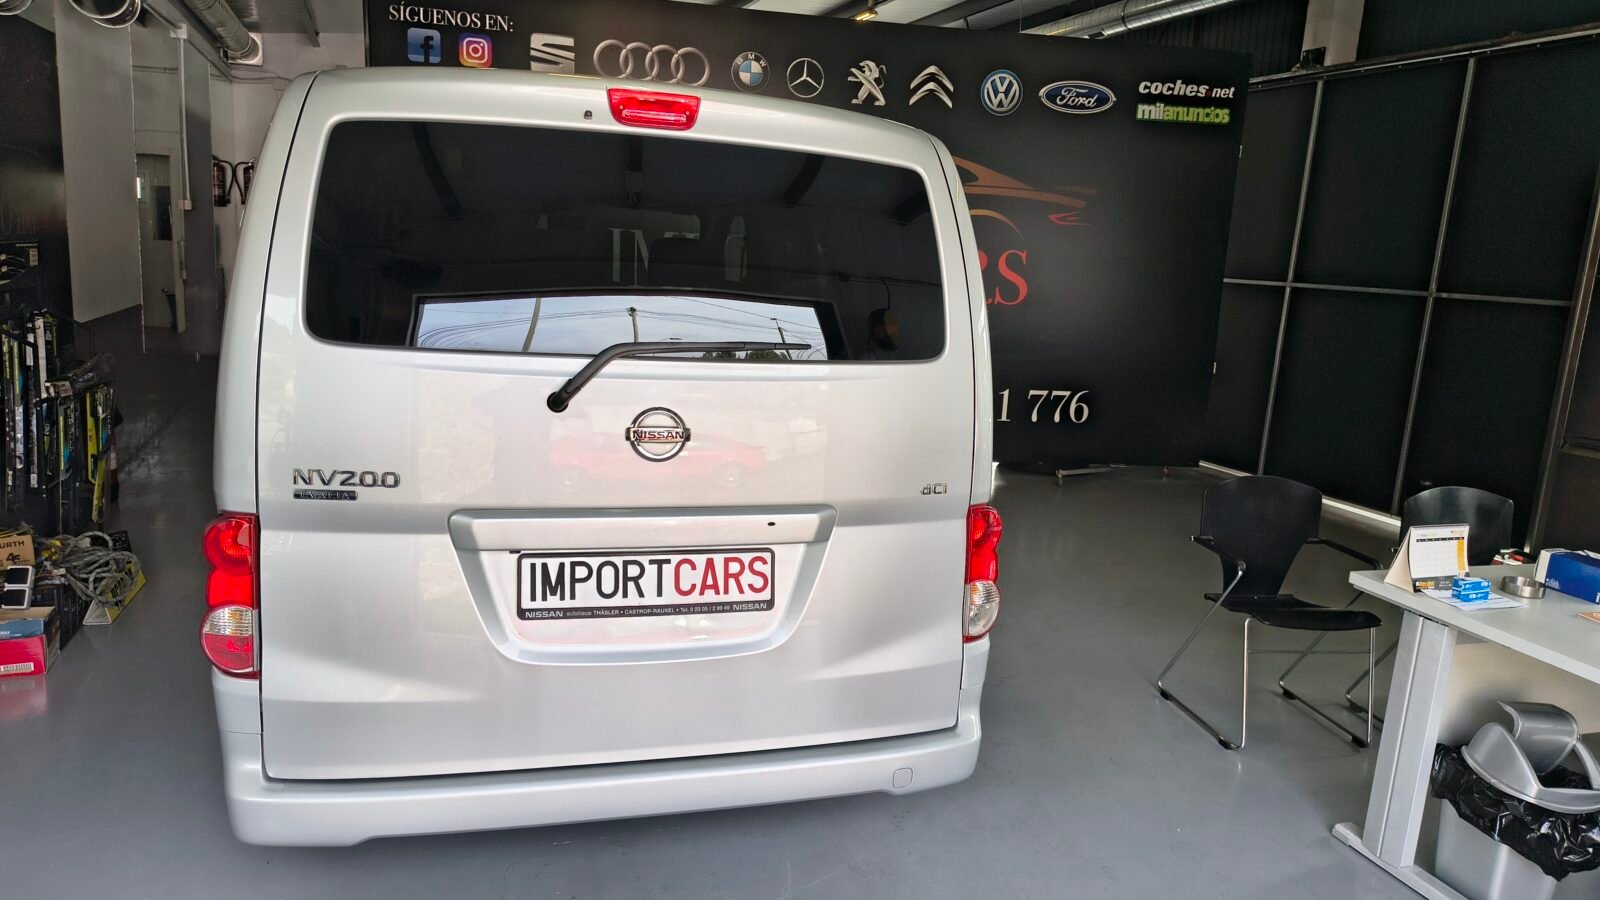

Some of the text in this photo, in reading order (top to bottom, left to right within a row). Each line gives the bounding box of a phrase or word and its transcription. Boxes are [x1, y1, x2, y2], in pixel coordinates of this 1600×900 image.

[388, 1, 514, 32] SÍGUENOS EN:
[1056, 86, 1098, 108] Ford
[1136, 102, 1231, 123] milanuncios
[1027, 389, 1090, 424] 776
[632, 429, 685, 440] NISSAN
[293, 468, 401, 488] NV200
[529, 555, 769, 602] IMPORTCARS
[525, 610, 564, 619] NISSAN
[732, 602, 767, 611] NISSAN
